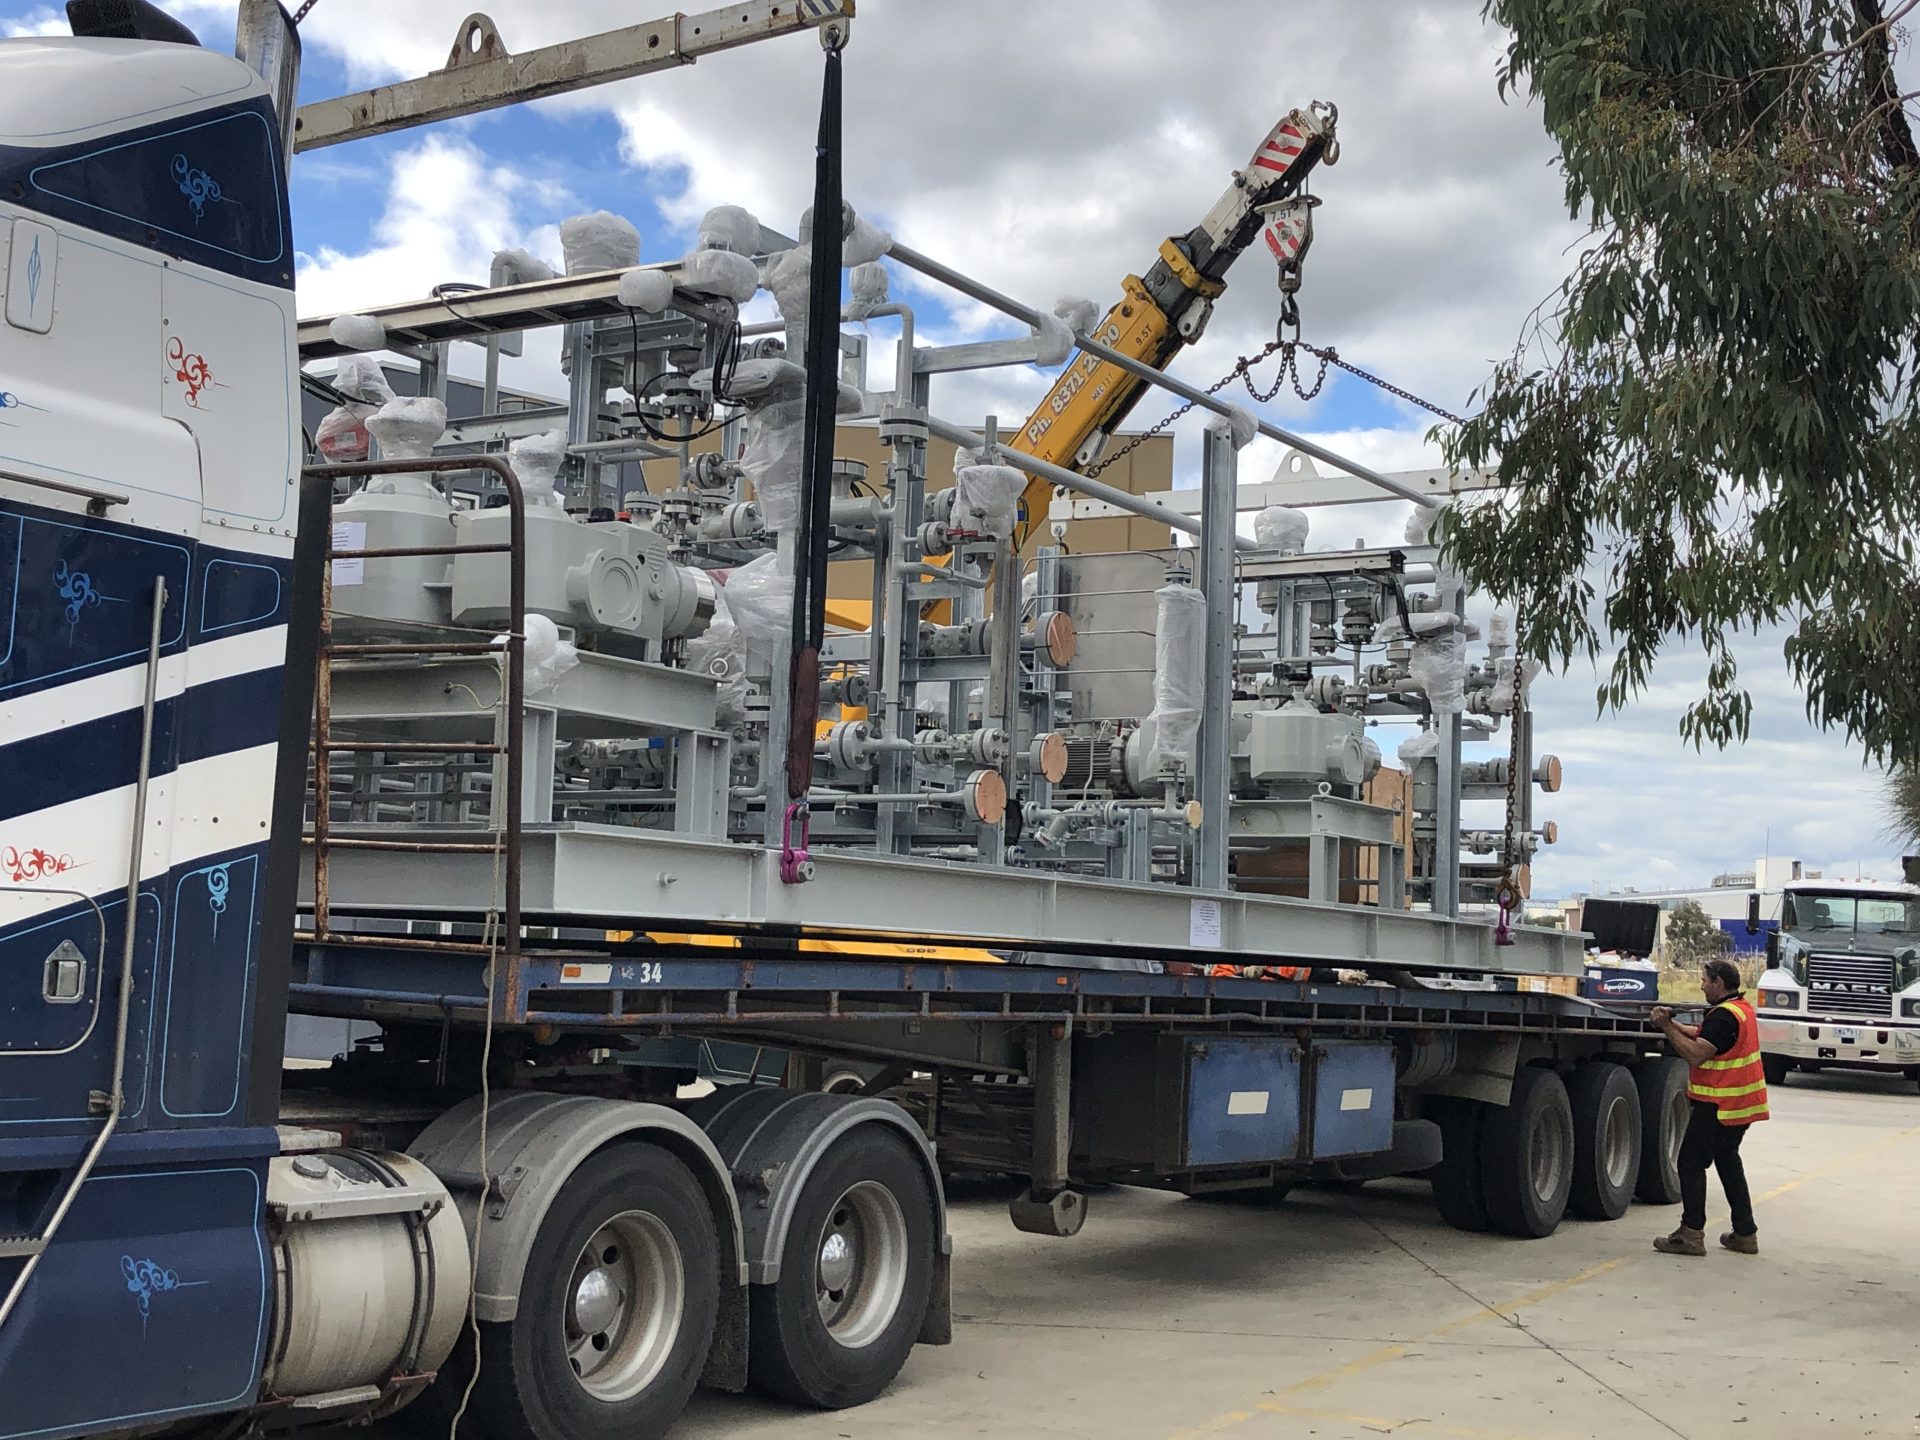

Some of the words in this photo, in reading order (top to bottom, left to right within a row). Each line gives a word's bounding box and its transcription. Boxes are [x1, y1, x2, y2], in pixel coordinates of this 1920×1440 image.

[1135, 323, 1152, 346] 9.5T
[1026, 416, 1052, 446] Ph.
[1050, 369, 1085, 415] 8371
[640, 962, 662, 984] 34
[1812, 982, 1888, 994] MACK
